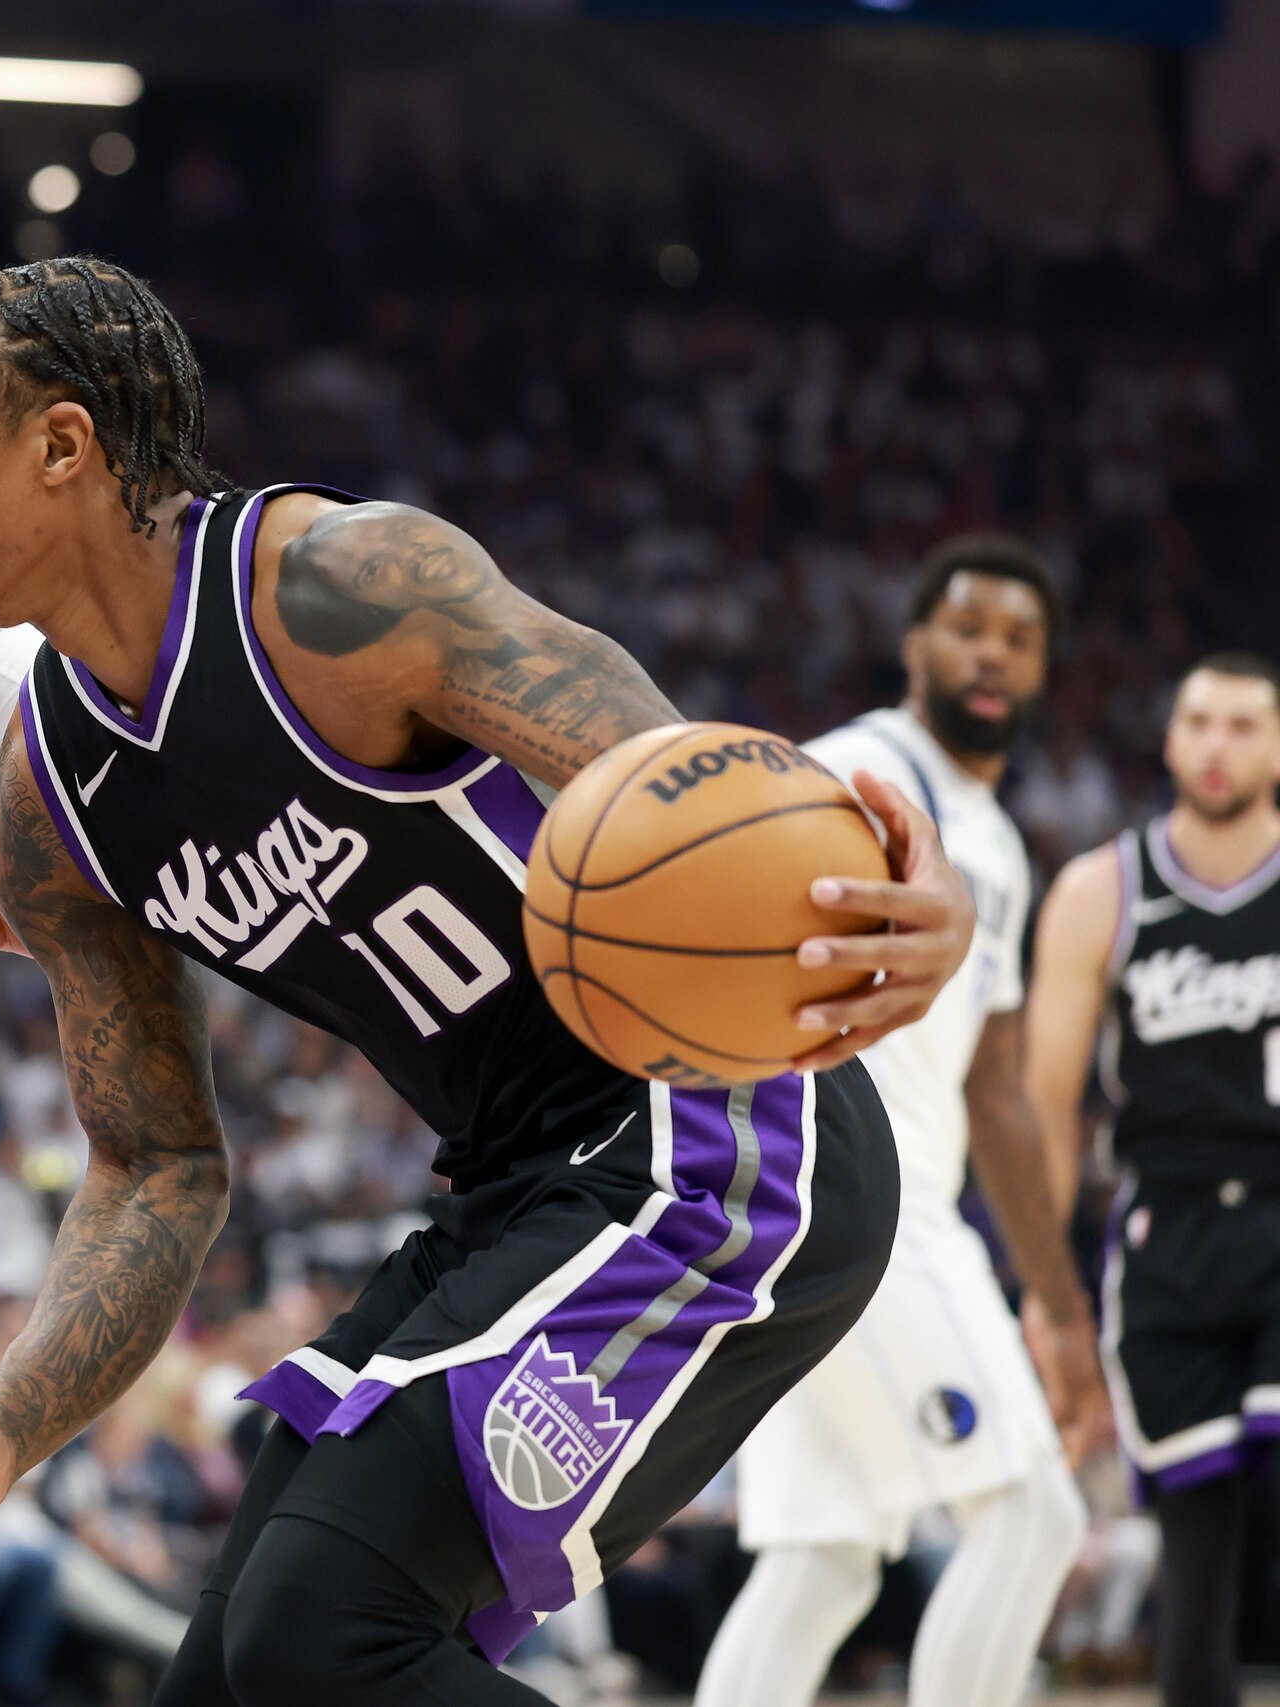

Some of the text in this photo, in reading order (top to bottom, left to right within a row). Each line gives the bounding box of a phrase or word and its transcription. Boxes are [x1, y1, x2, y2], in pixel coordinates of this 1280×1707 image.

[642, 738, 820, 804] ilson
[144, 797, 369, 973] Kings
[339, 884, 513, 1038] 10
[105, 1077, 125, 1093] TOO
[498, 1382, 594, 1488] KINGS
[520, 1369, 605, 1458] SACRAMENTO
